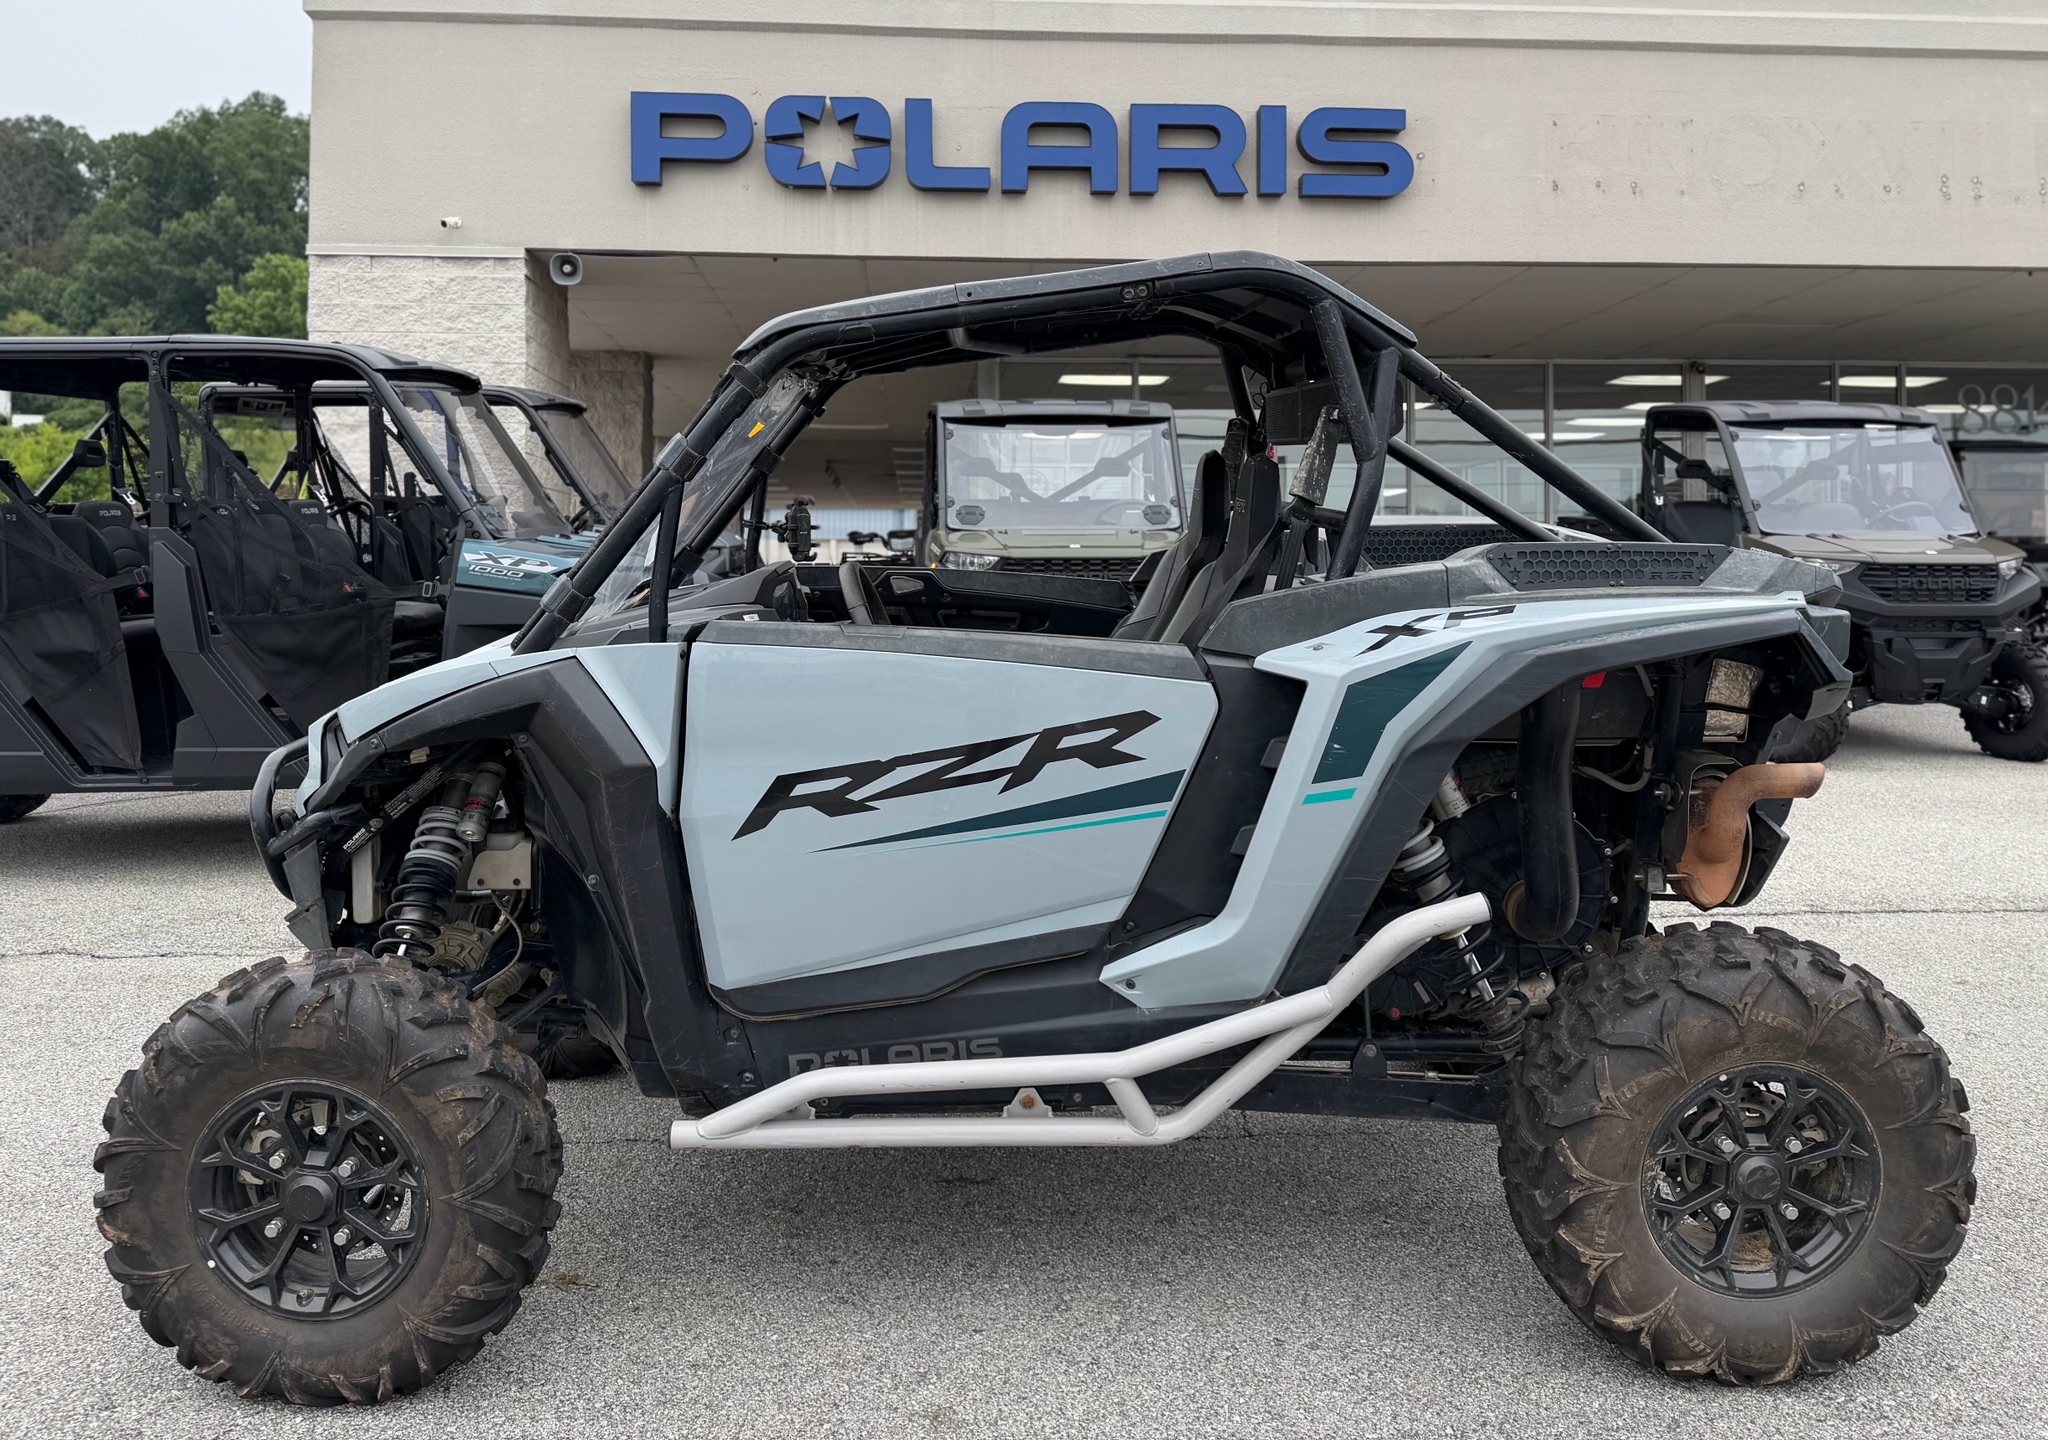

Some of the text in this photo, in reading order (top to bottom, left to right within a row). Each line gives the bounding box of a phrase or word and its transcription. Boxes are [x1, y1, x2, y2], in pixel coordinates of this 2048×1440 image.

[630, 90, 1415, 199] POLARIS
[468, 550, 553, 570] XP
[468, 564, 525, 578] 1000
[1897, 576, 1981, 590] POLARIS
[1353, 604, 1518, 658] XP
[731, 709, 1163, 842] RZR
